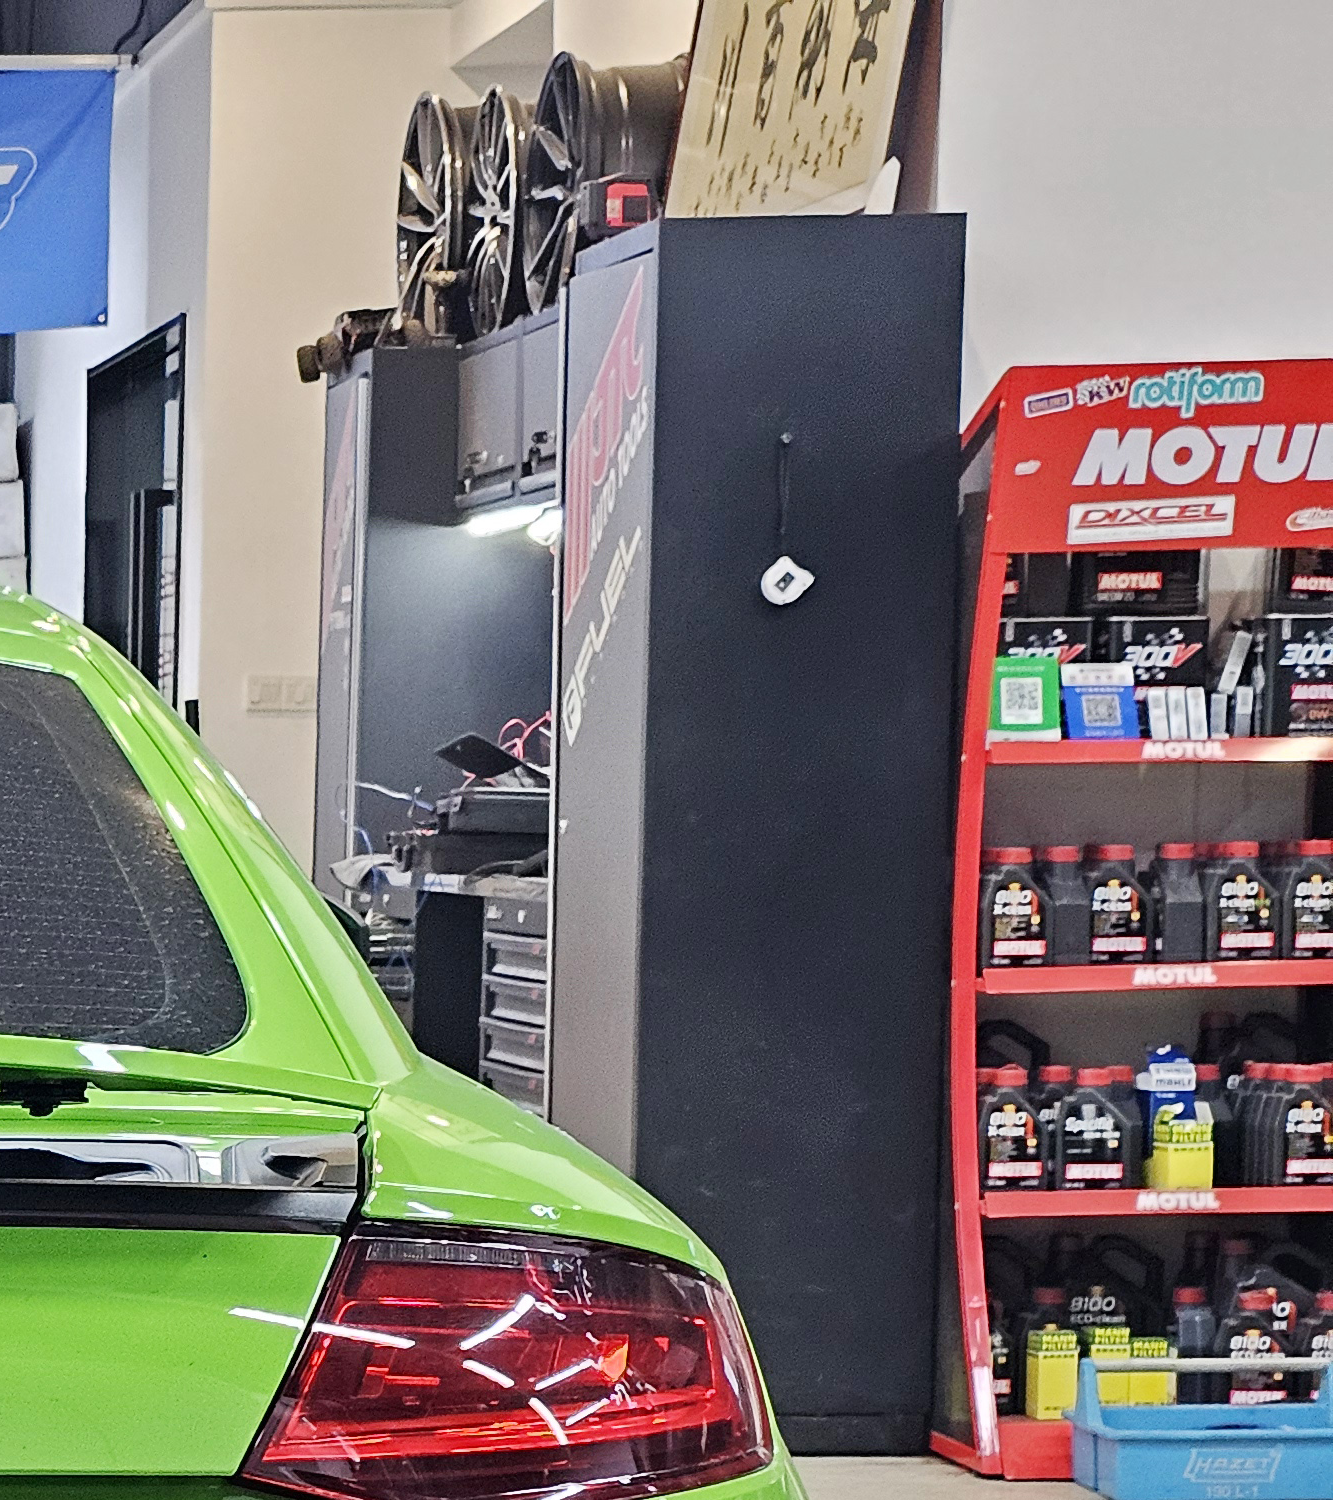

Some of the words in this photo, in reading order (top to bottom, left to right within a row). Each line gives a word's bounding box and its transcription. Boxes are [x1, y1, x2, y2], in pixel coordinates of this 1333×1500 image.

[1131, 369, 1262, 415] rotiform
[1077, 503, 1228, 527] DIXCEL
[1120, 642, 1204, 668] 300V
[1279, 643, 1333, 665] 300
[1141, 740, 1226, 759] MOTUL
[1133, 966, 1218, 985] MOTUL
[1136, 1191, 1221, 1211] MOTUL
[1194, 1456, 1271, 1471] HAZET
